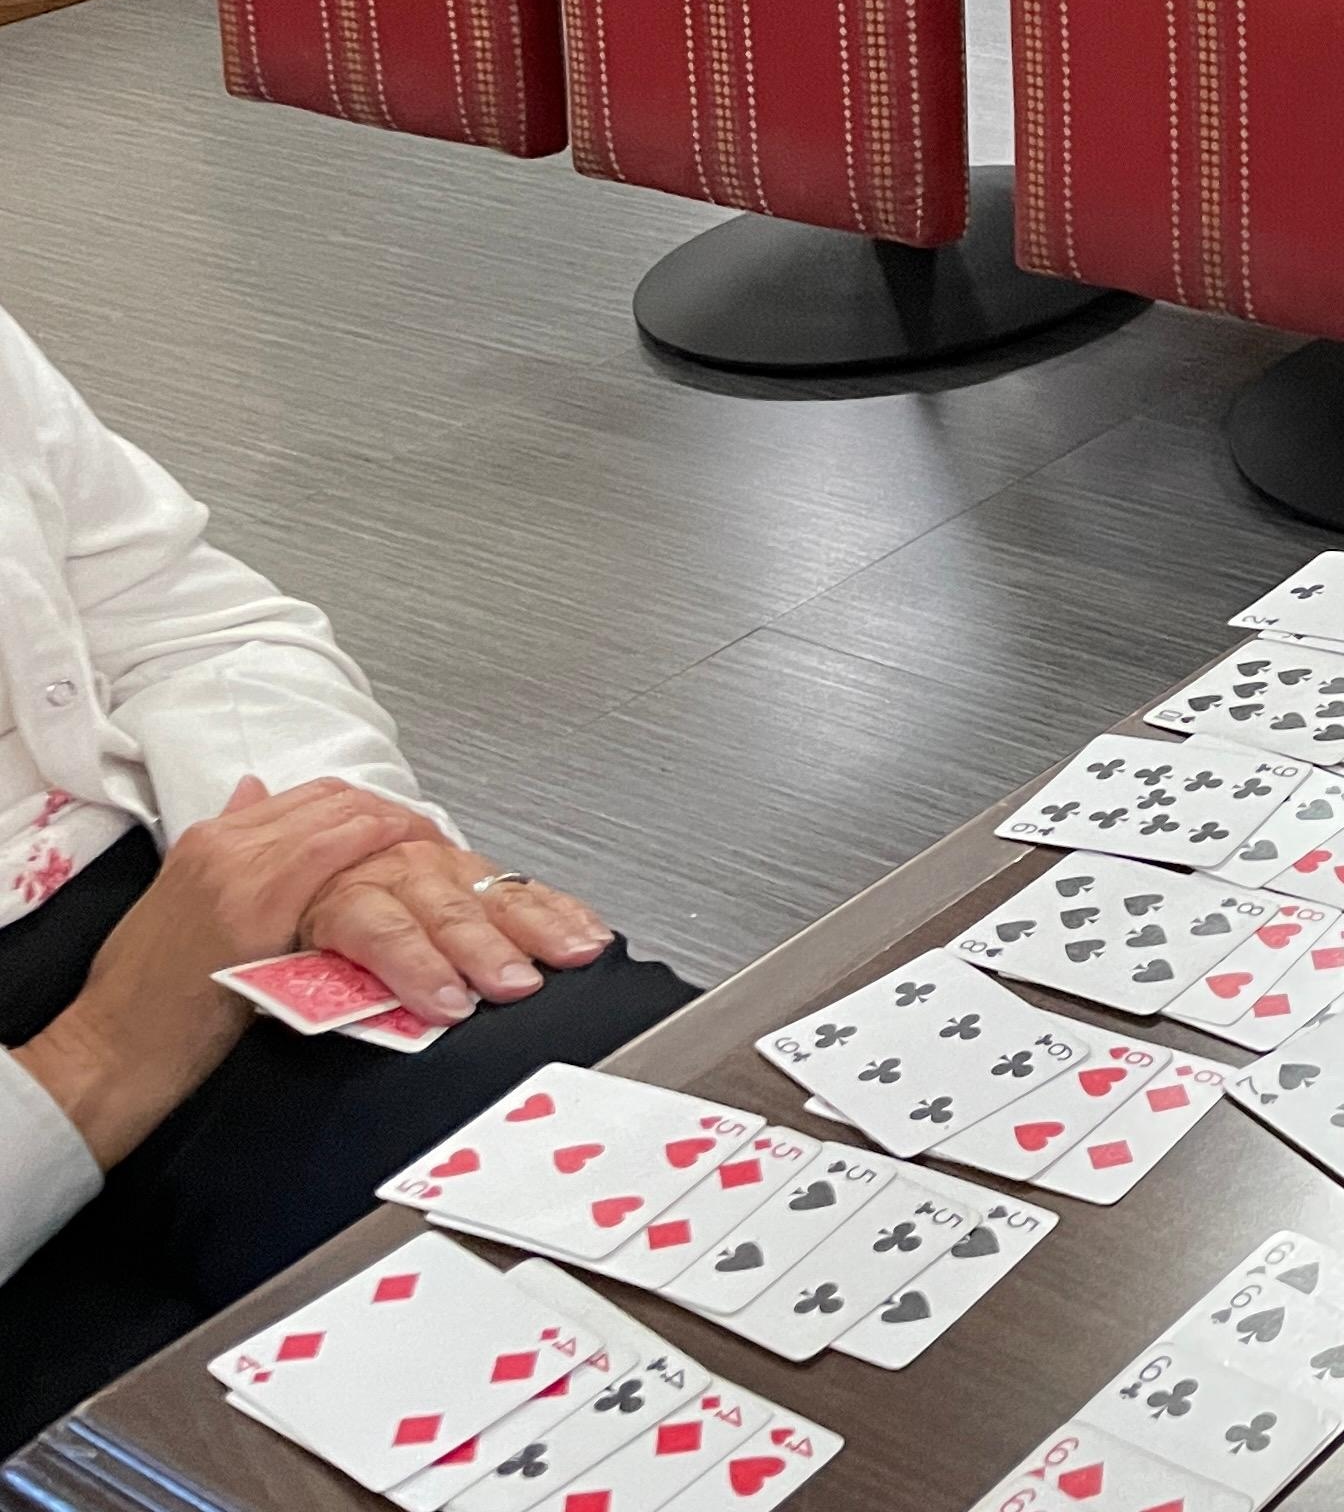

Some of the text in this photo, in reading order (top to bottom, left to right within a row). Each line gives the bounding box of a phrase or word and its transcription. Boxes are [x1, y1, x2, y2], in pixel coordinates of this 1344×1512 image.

[1237, 902, 1265, 917] 8
[1297, 907, 1325, 921] 8
[960, 940, 987, 952] 8
[1236, 1076, 1258, 1095] 7
[715, 1119, 746, 1138] 5
[771, 1142, 801, 1161] 5
[846, 1165, 877, 1183] 5
[932, 1208, 963, 1229] 5
[1007, 1211, 1040, 1232] 5
[1264, 1240, 1295, 1265] 6
[1230, 1284, 1263, 1308] 6
[552, 1337, 577, 1357] 4
[1138, 1355, 1173, 1382] 6
[661, 1369, 685, 1389] 4
[714, 1406, 742, 1427] 4
[785, 1438, 814, 1458] 4
[1044, 1436, 1080, 1466] 6
[1000, 1488, 1037, 1512] 6
